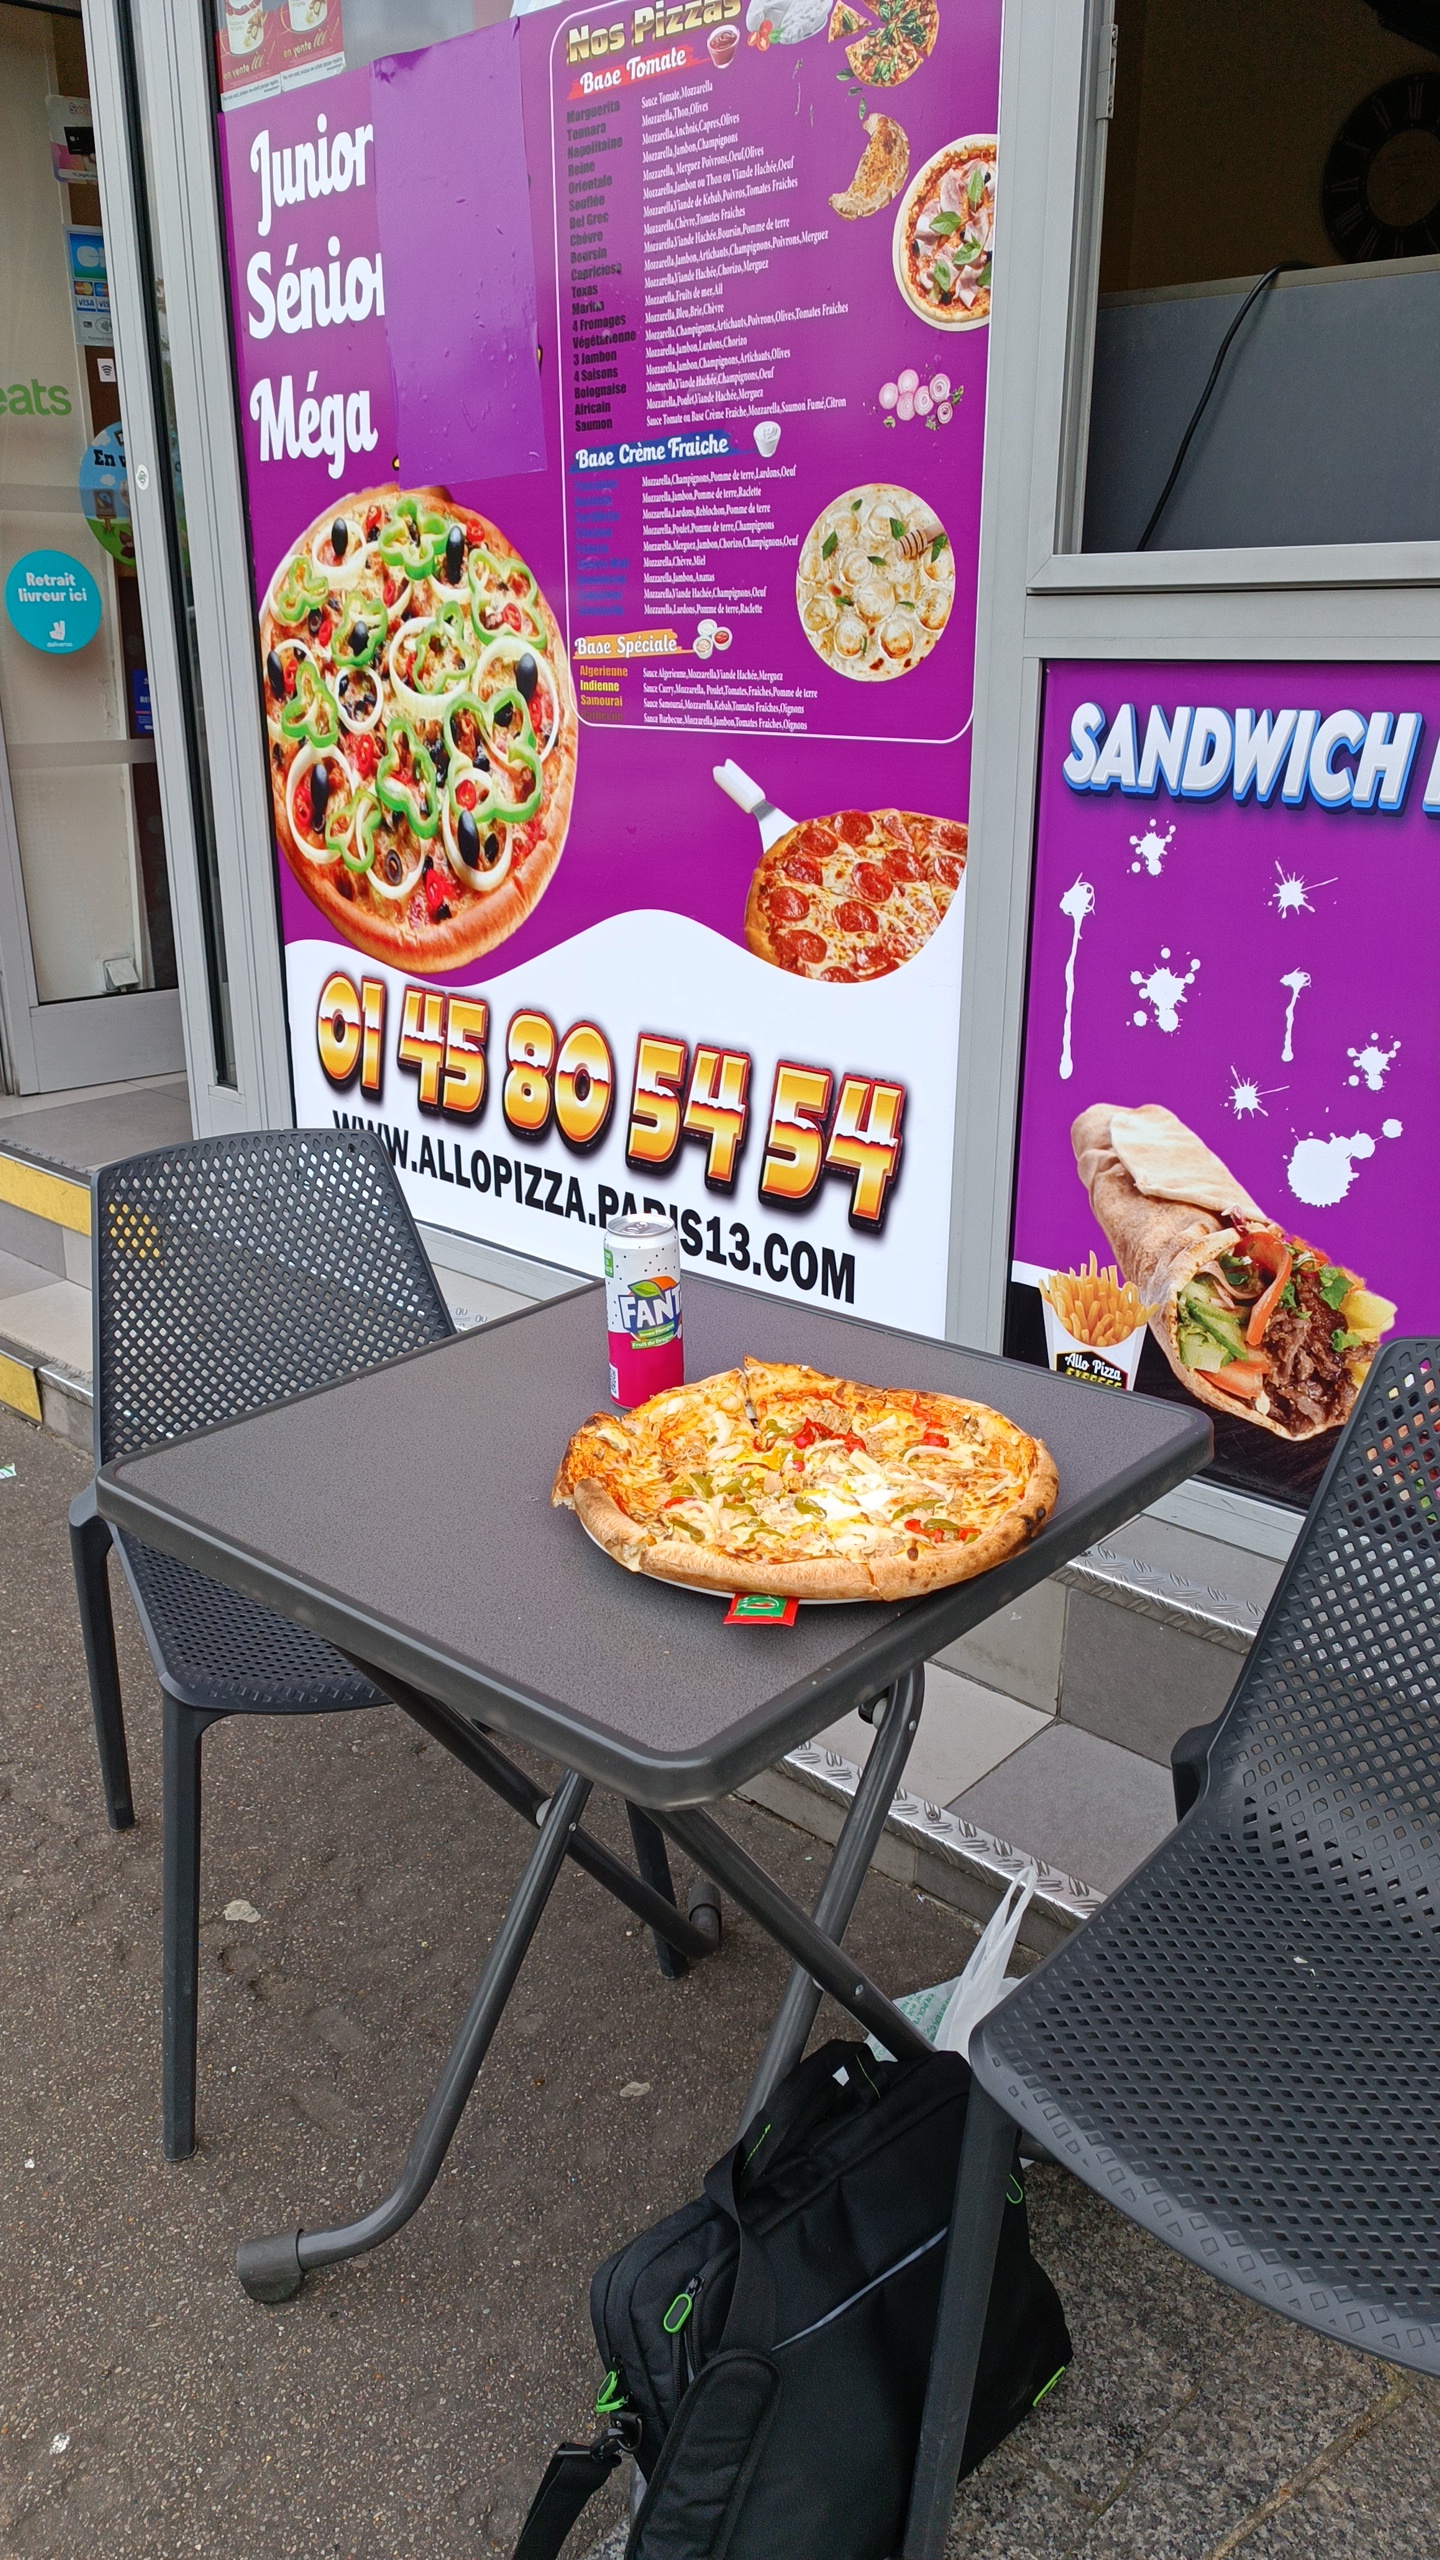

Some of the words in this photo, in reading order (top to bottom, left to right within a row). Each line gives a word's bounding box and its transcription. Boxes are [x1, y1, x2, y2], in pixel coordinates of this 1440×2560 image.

[566, 23, 626, 65] Nos
[632, 0, 742, 47] Pizzas
[283, 49, 292, 58] en
[293, 41, 312, 58] vente
[313, 25, 329, 48] ici
[223, 70, 232, 80] en
[232, 64, 250, 78] vente
[251, 52, 264, 71] ici
[580, 69, 622, 94] Base
[626, 47, 686, 80] Tomate
[642, 97, 658, 108] Sauce
[250, 113, 374, 237] Junior
[676, 161, 700, 175] Merguez
[697, 179, 705, 188] ou
[706, 173, 722, 186] Thon
[723, 173, 731, 182] ou
[732, 165, 753, 180] Viande
[695, 195, 702, 207] de
[772, 176, 798, 191] Fraiches
[586, 212, 608, 226] Grec
[721, 206, 745, 220] Fraiches
[766, 218, 774, 230] de
[775, 218, 790, 229] terre
[570, 247, 607, 264] Boursin
[572, 284, 598, 298] Texas
[693, 286, 700, 299] de
[822, 301, 848, 316] Fraiches
[572, 320, 578, 332] 4
[580, 315, 626, 331] Fromages
[573, 354, 579, 366] 3
[581, 351, 616, 365] Jambon
[574, 371, 579, 382] 4
[582, 368, 618, 381] Saisons
[574, 383, 626, 399] Bolognaise
[575, 401, 611, 416] Africain
[250, 370, 378, 479] Méga
[576, 418, 612, 432] Saumon
[646, 415, 662, 427] Sauce
[663, 413, 682, 425] Tomate
[684, 414, 690, 423] ou
[691, 411, 704, 422] Base
[705, 408, 724, 420] Crème
[94, 449, 116, 467] En
[576, 448, 614, 469] Base
[619, 439, 666, 464] Crème
[668, 434, 729, 456] Fraiche
[733, 469, 740, 480] de
[715, 487, 722, 499] de
[748, 502, 755, 513] de
[756, 503, 770, 513] terre
[713, 521, 719, 532] de
[26, 572, 76, 586] Retrait
[18, 588, 66, 602] livreur
[69, 588, 87, 602] ici
[717, 603, 724, 614] de
[575, 637, 612, 654] Base
[617, 634, 678, 658] Spéciale
[580, 665, 628, 677] Algerienne
[643, 667, 659, 678] Sauce
[580, 680, 619, 692] Indienne
[643, 683, 658, 693] Sauce
[795, 687, 803, 698] de
[802, 688, 818, 698] terre
[580, 695, 622, 706] Samourai
[643, 698, 658, 708] Sauce
[644, 713, 658, 724] Sauce
[1062, 701, 1422, 811] SANDWICH
[316, 971, 385, 1099] 01
[397, 982, 492, 1127] 45
[502, 1008, 617, 1157] 80
[625, 1031, 752, 1193] 54
[758, 1059, 906, 1234] 54
[618, 1283, 682, 1328] FANT
[1065, 1352, 1090, 1370] Allo
[1092, 1360, 1121, 1380] Pizza
